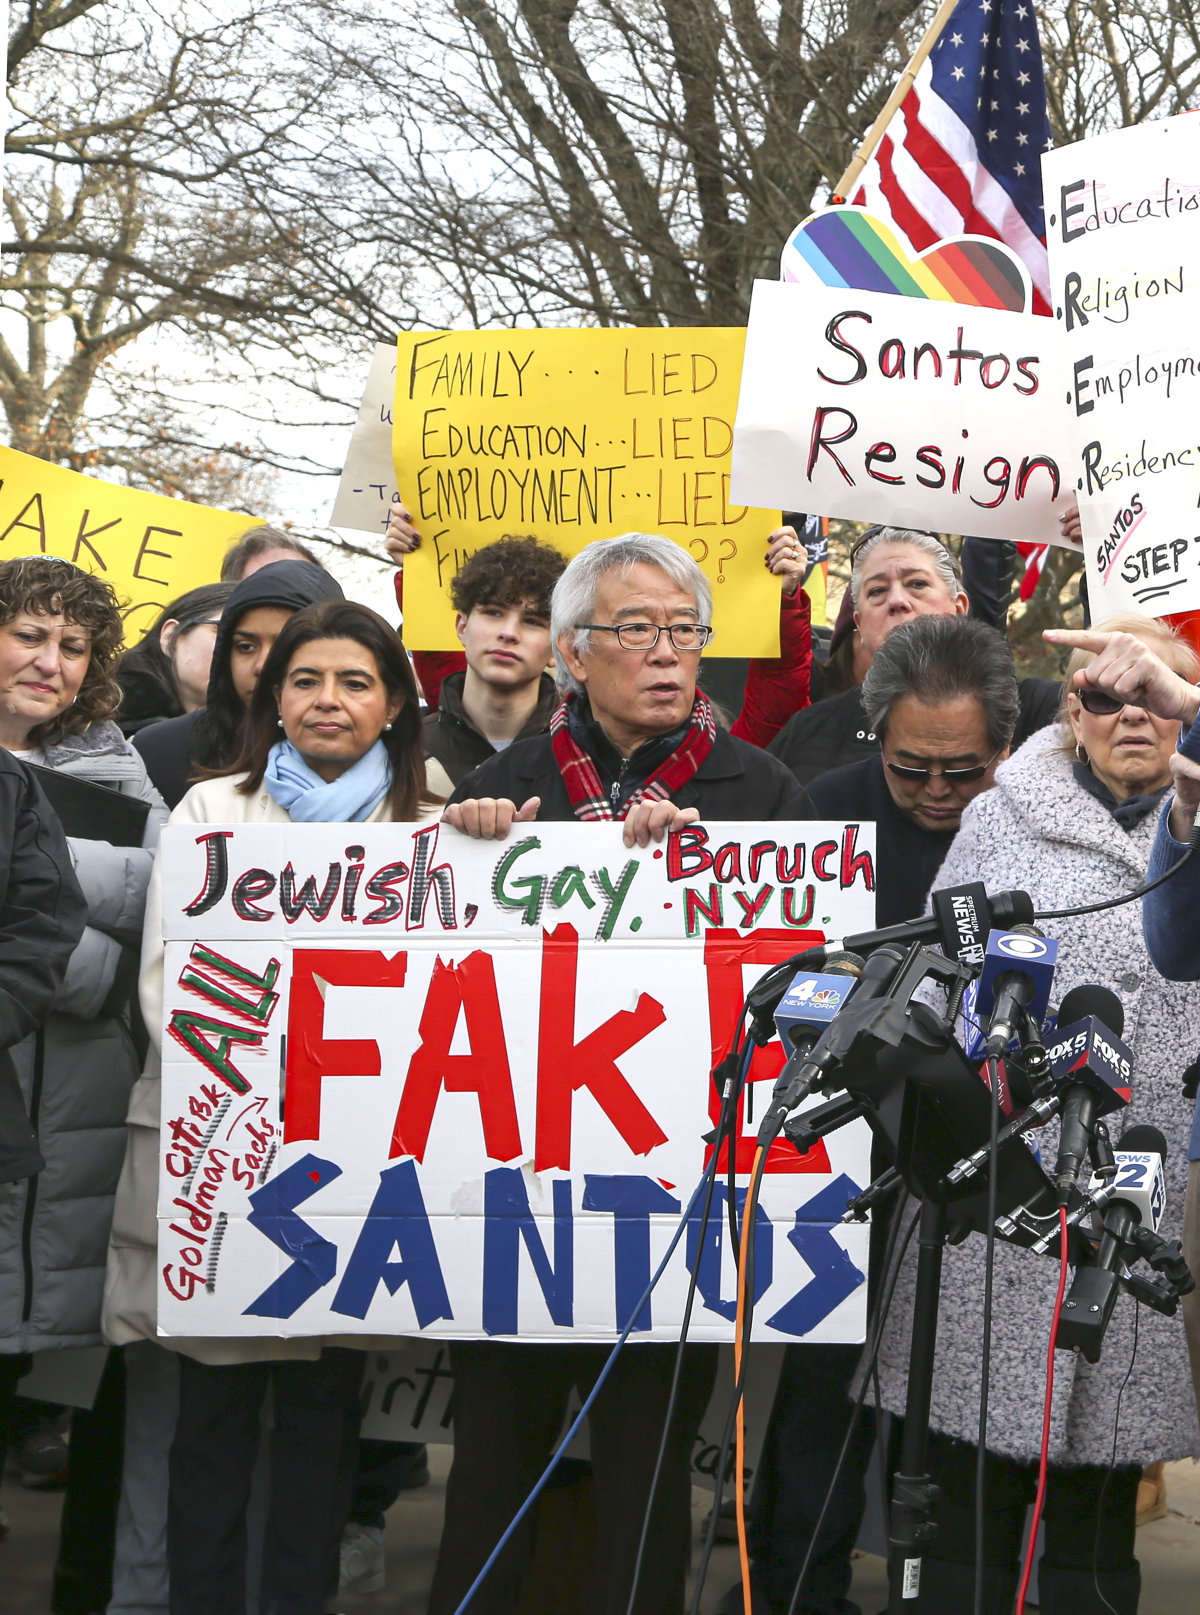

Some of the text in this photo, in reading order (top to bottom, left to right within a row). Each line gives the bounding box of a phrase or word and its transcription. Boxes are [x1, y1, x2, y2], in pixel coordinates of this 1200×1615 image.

[622, 347, 718, 397] LIED
[817, 310, 1040, 396] Santos
[632, 416, 734, 459] LIED
[806, 406, 1060, 508] Resign
[0, 478, 183, 587] AKE
[1097, 492, 1146, 573] SANTOS
[1120, 537, 1189, 584] STEP
[181, 823, 876, 943] Jewish, Gay. Baruch
[683, 882, 832, 938] NYU.
[951, 896, 976, 945] NEWS
[966, 895, 980, 933] SPECTRUM
[782, 999, 837, 1010] NEW YORK
[787, 979, 818, 1001] 4
[165, 942, 282, 1097] ALL
[1114, 1154, 1151, 1163] ews
[162, 1148, 231, 1302] Goldman
[241, 1152, 866, 1337] SANTOS
